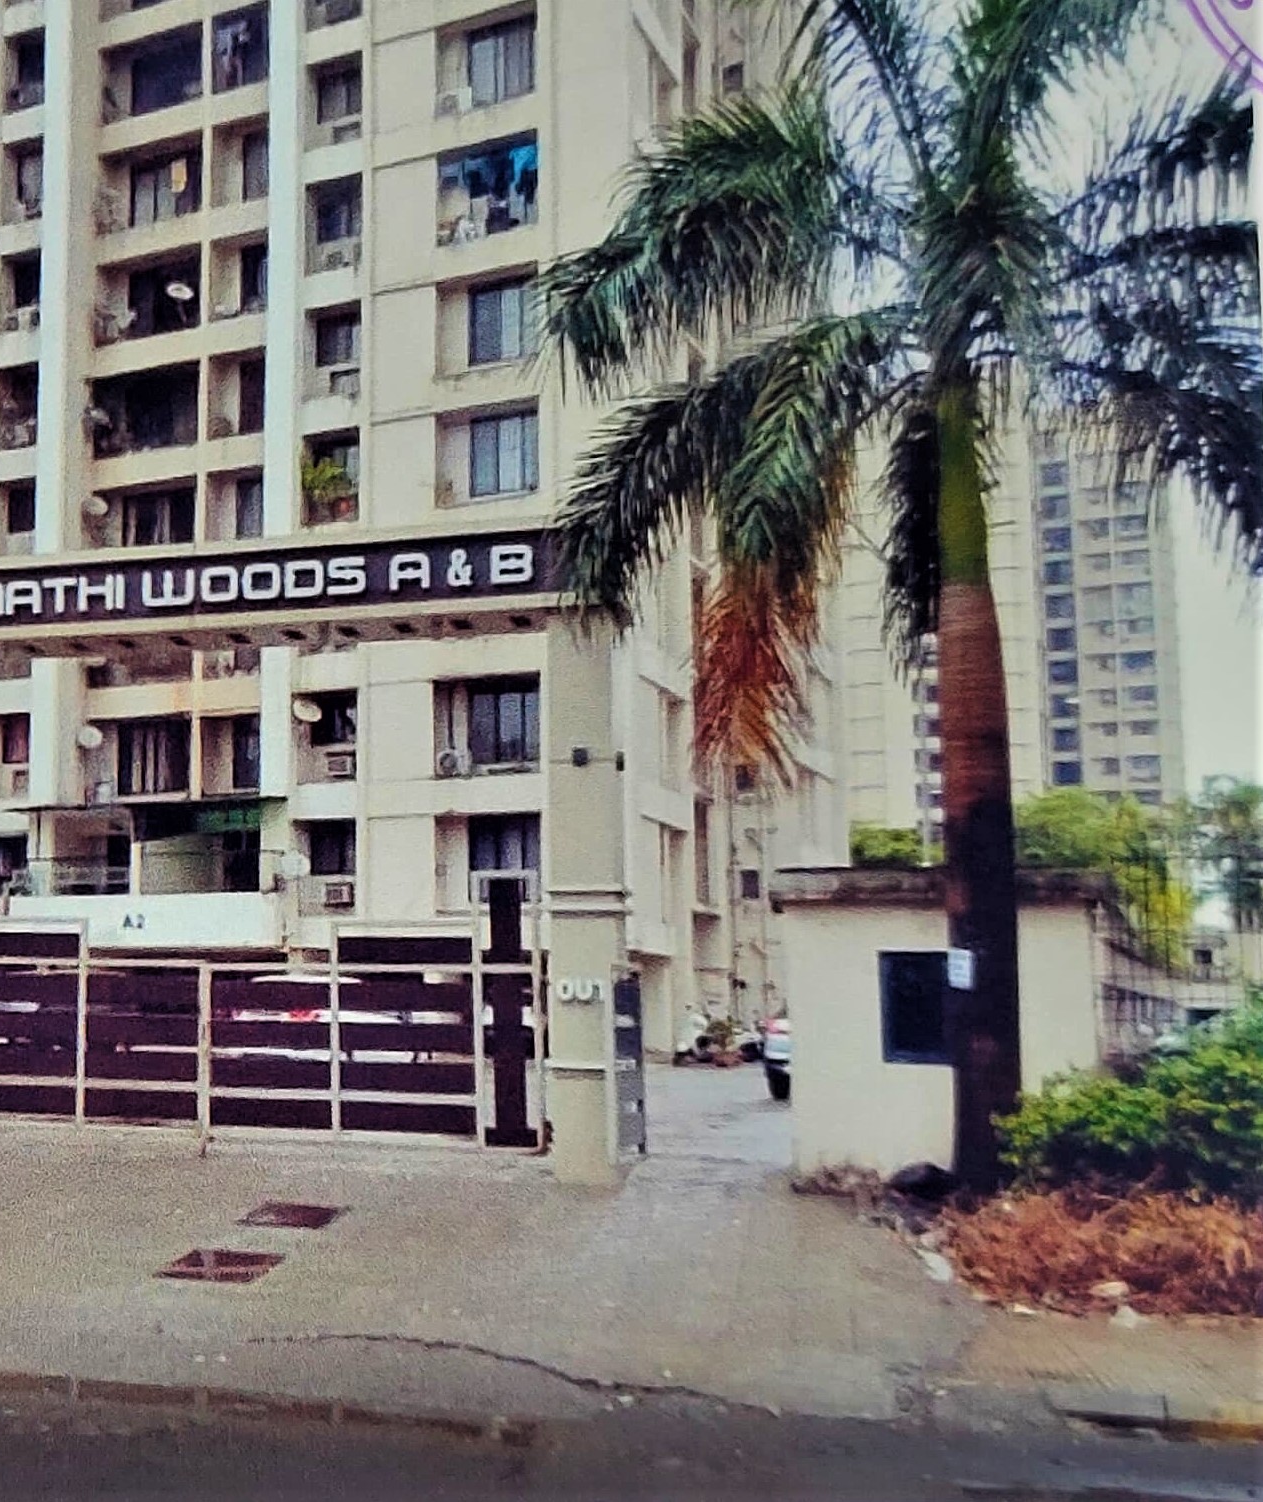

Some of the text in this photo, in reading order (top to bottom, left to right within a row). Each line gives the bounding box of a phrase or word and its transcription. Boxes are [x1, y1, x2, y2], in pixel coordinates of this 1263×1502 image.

[142, 556, 367, 607] WOODS
[389, 552, 431, 592] A
[447, 549, 473, 587] &
[489, 544, 534, 585] B
